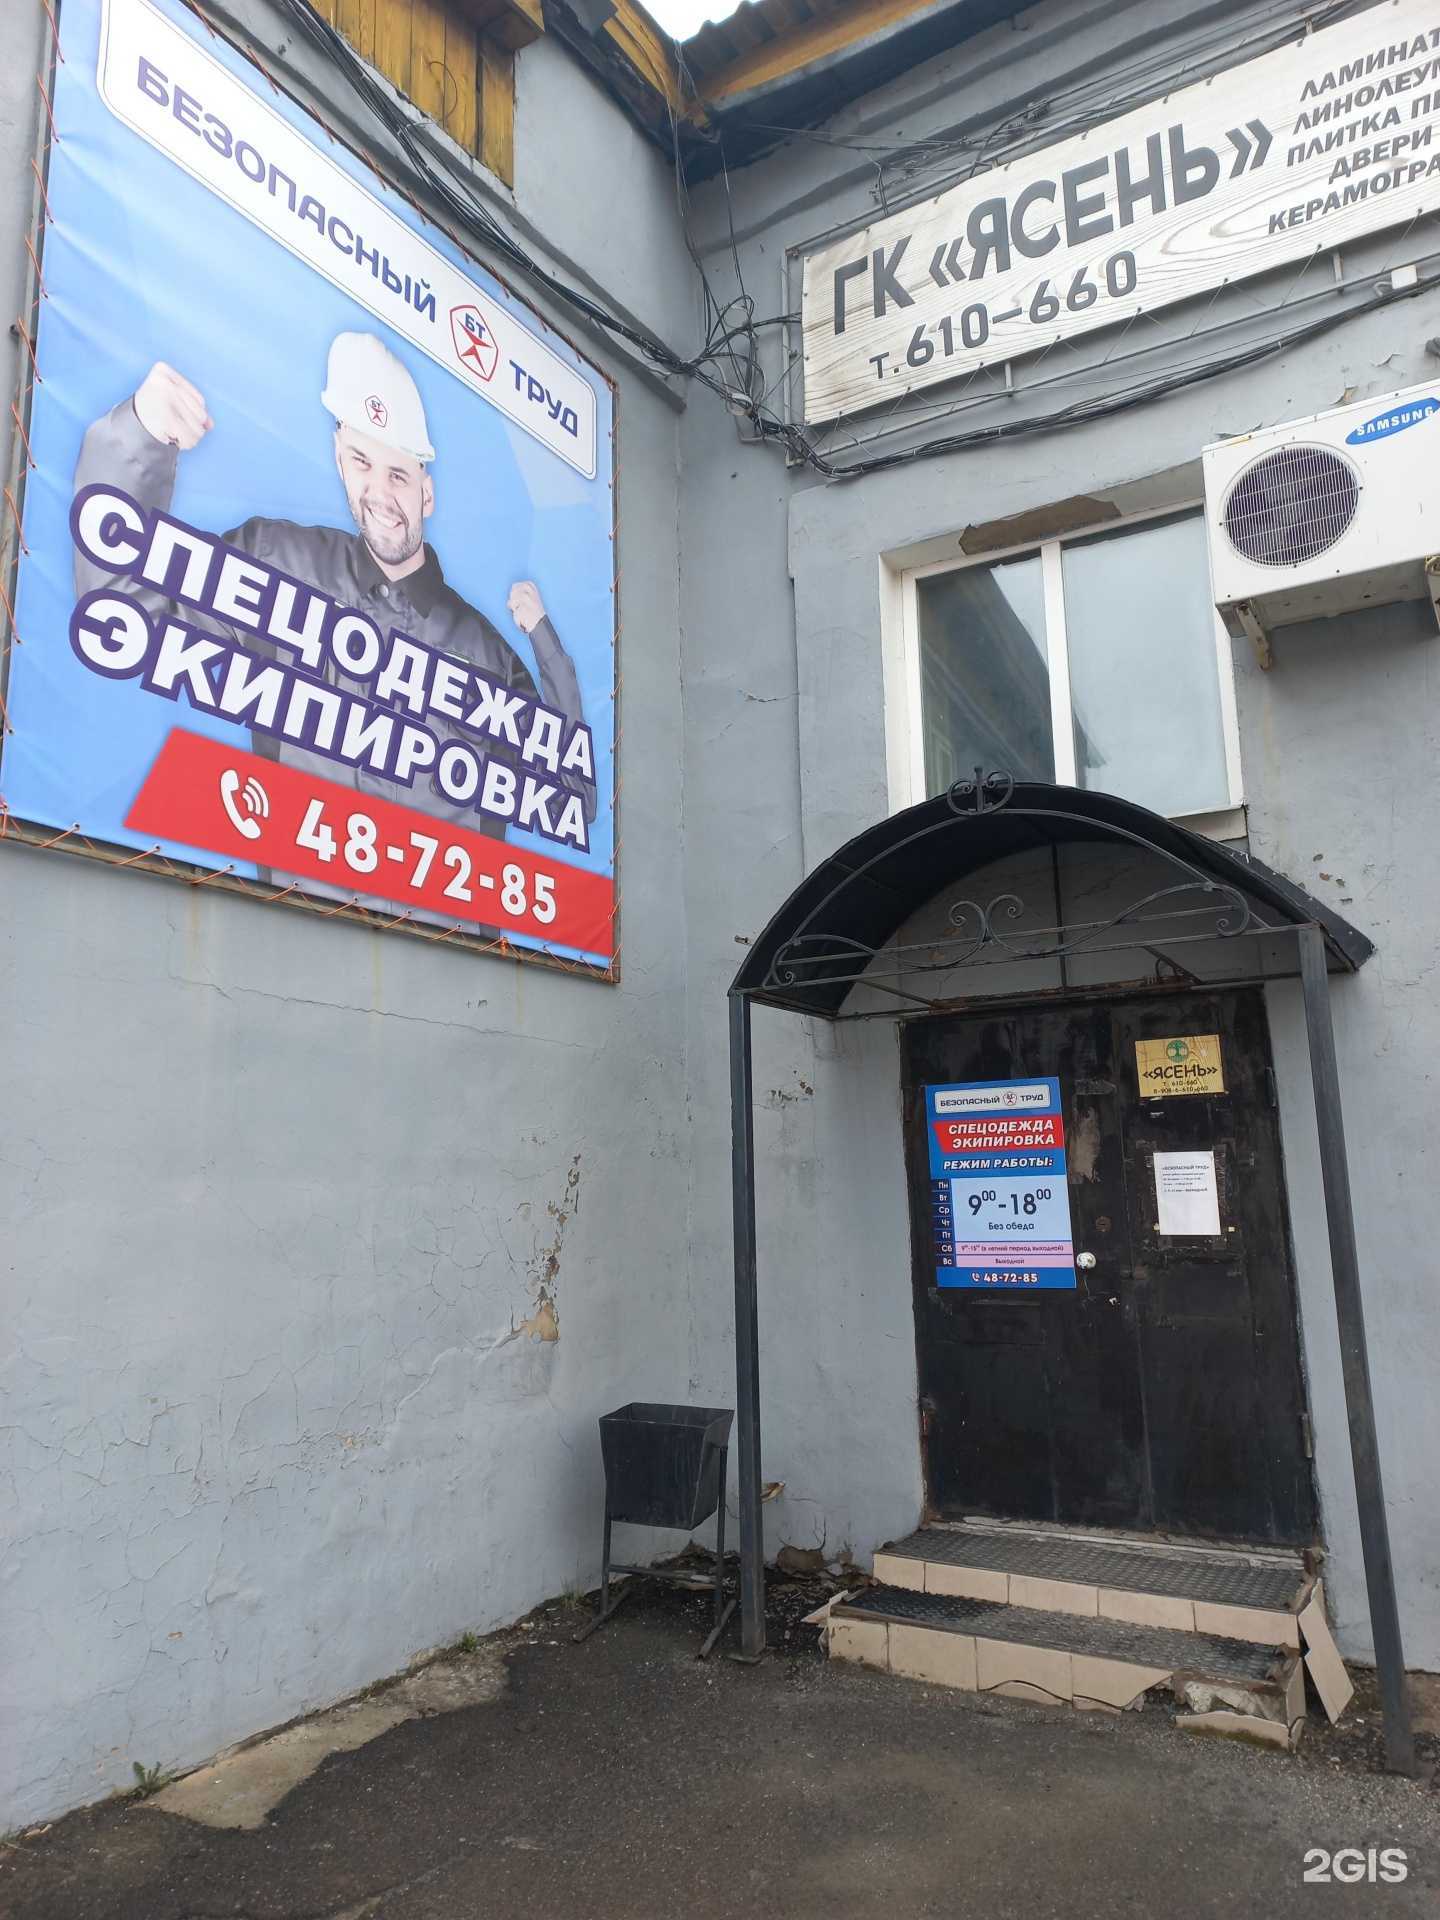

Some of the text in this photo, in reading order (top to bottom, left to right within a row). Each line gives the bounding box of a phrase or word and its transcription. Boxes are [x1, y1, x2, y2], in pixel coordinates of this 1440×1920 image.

[1286, 106, 1402, 167] ПЛИТКА
[1328, 125, 1432, 185] ДВЕРИ
[834, 118, 1273, 336] ГК «ЯСЕНЬ»
[137, 55, 578, 438] БЕЗОПАСНЫЙ БТ ТРУД
[1356, 406, 1434, 436] SAMSUNG
[74, 489, 597, 780] СПЕЦОДЕЖДА
[74, 593, 589, 850] ЭКИПИРОВКА
[295, 798, 558, 925] 48-72-85
[1142, 1064, 1218, 1080] «ЯСЕНЬ»
[940, 1096, 1000, 1107] БЕЗОПАСНЫЙ
[1020, 1094, 1044, 1102] ТРУД
[948, 1119, 1054, 1135] СПЕЦОДЕЖДА
[952, 1134, 1055, 1149] ЭКИПИРОВКА
[943, 1157, 1053, 1171] РЕЖИМ РАБОТЫ:
[938, 1181, 949, 1189] Пн
[938, 1206, 950, 1215] Ср
[941, 1219, 951, 1227] Чт
[988, 1222, 1035, 1231] Без обеда
[942, 1231, 951, 1239] Пт
[941, 1245, 953, 1253] Сб
[983, 1273, 1038, 1283] 48-72-85
